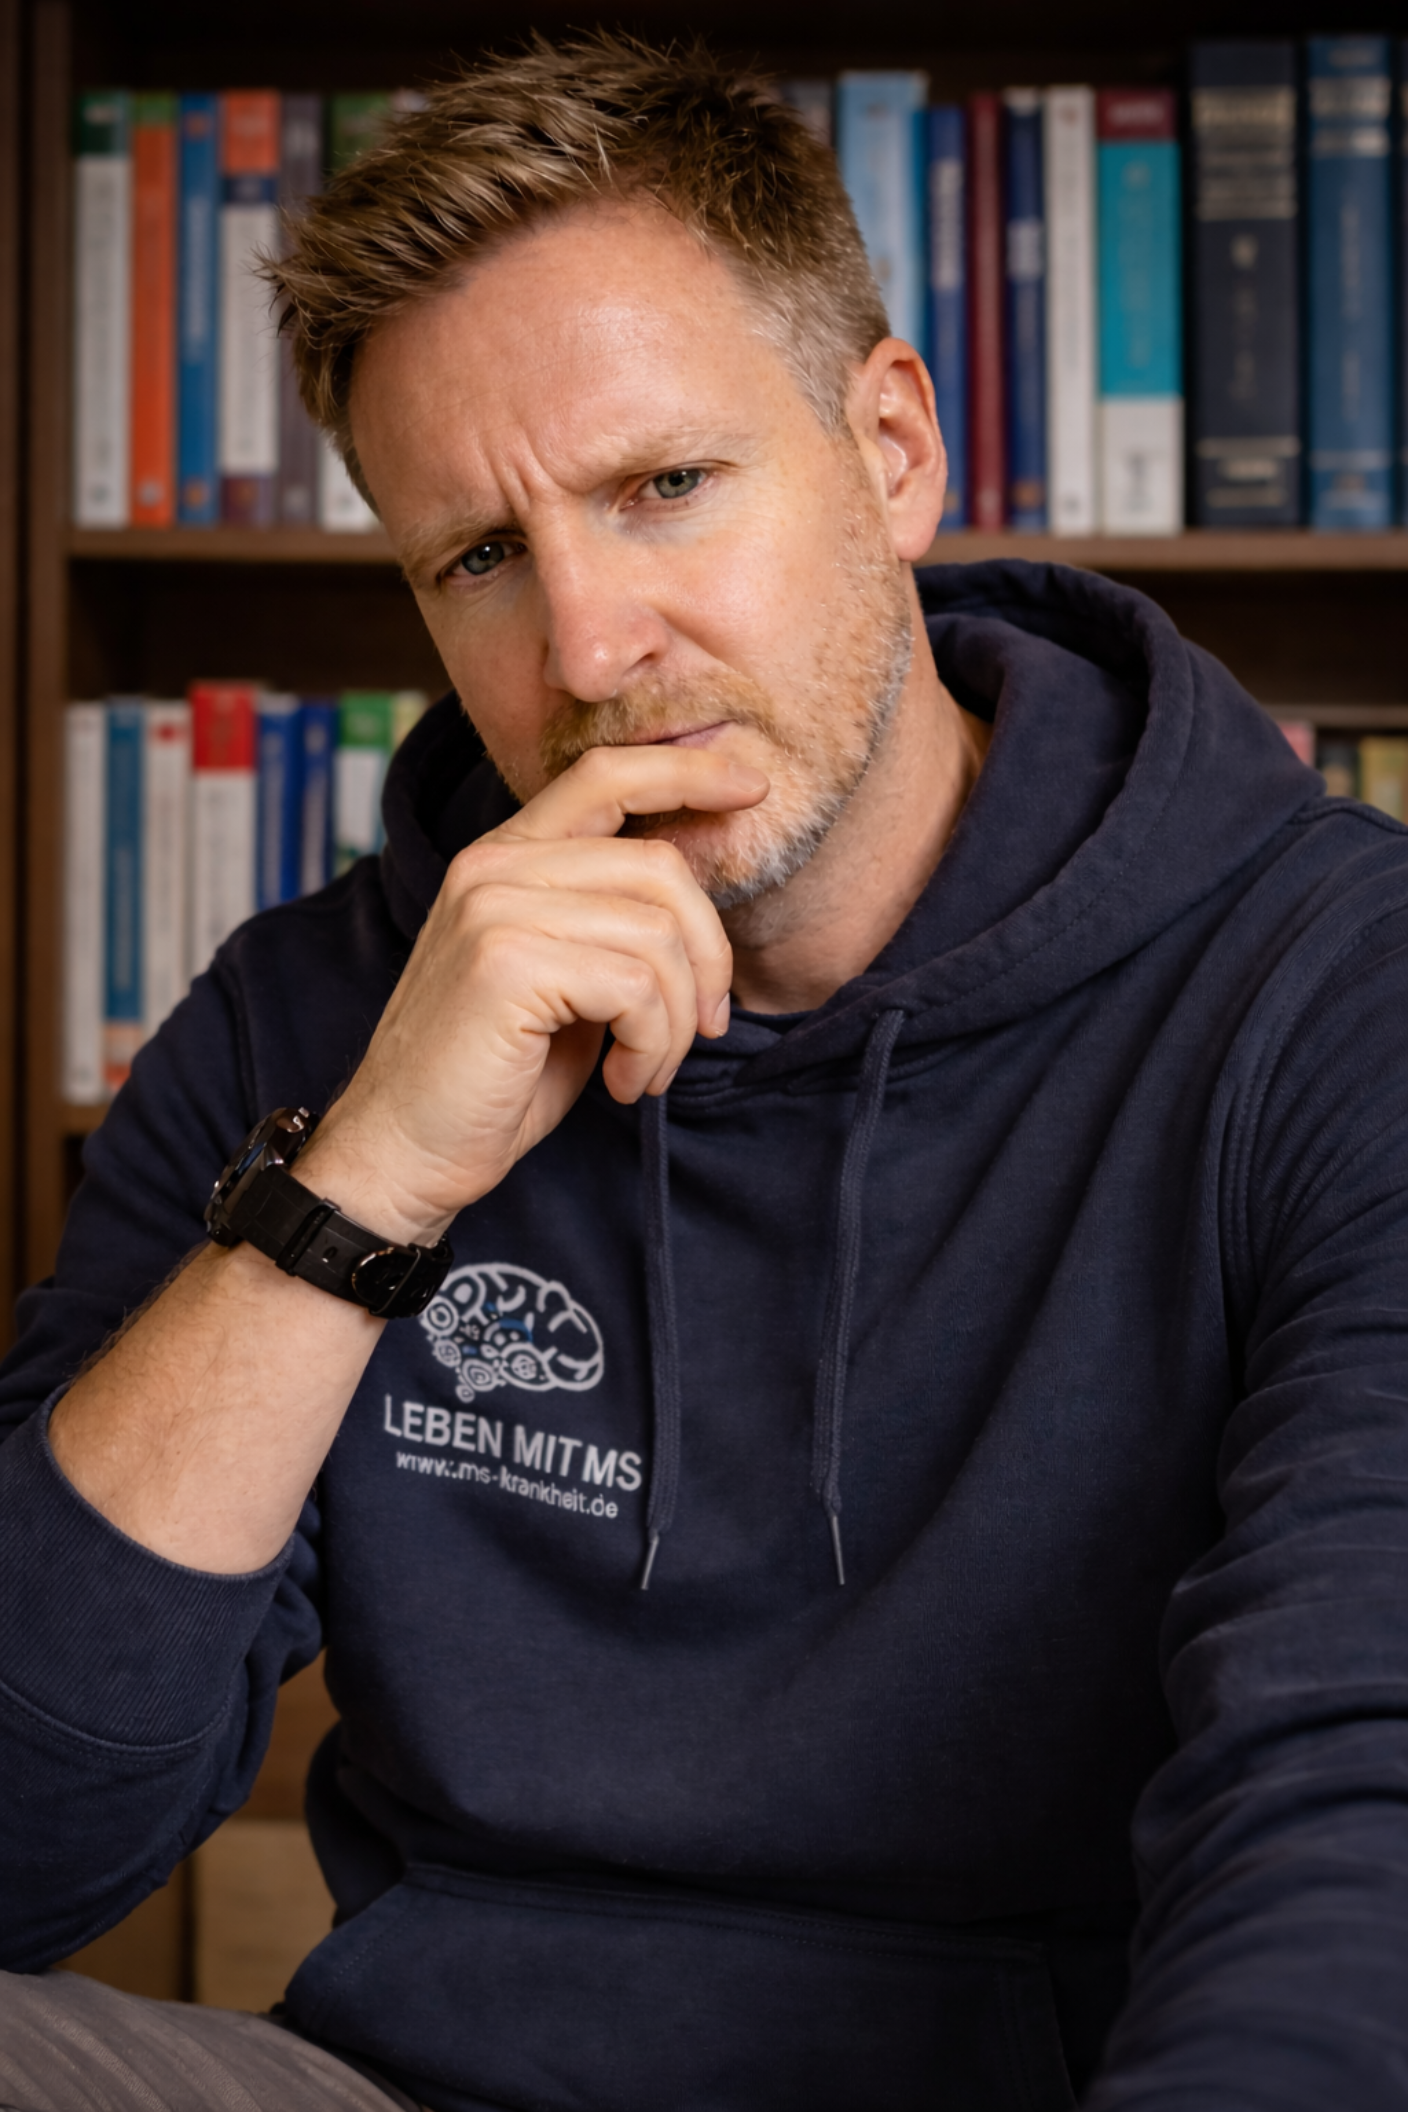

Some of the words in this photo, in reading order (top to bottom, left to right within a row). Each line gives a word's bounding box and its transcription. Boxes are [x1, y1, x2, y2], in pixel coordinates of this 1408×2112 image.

[384, 1394, 503, 1458] LEBEN
[513, 1424, 583, 1477] MIT
[582, 1445, 642, 1491] MS
